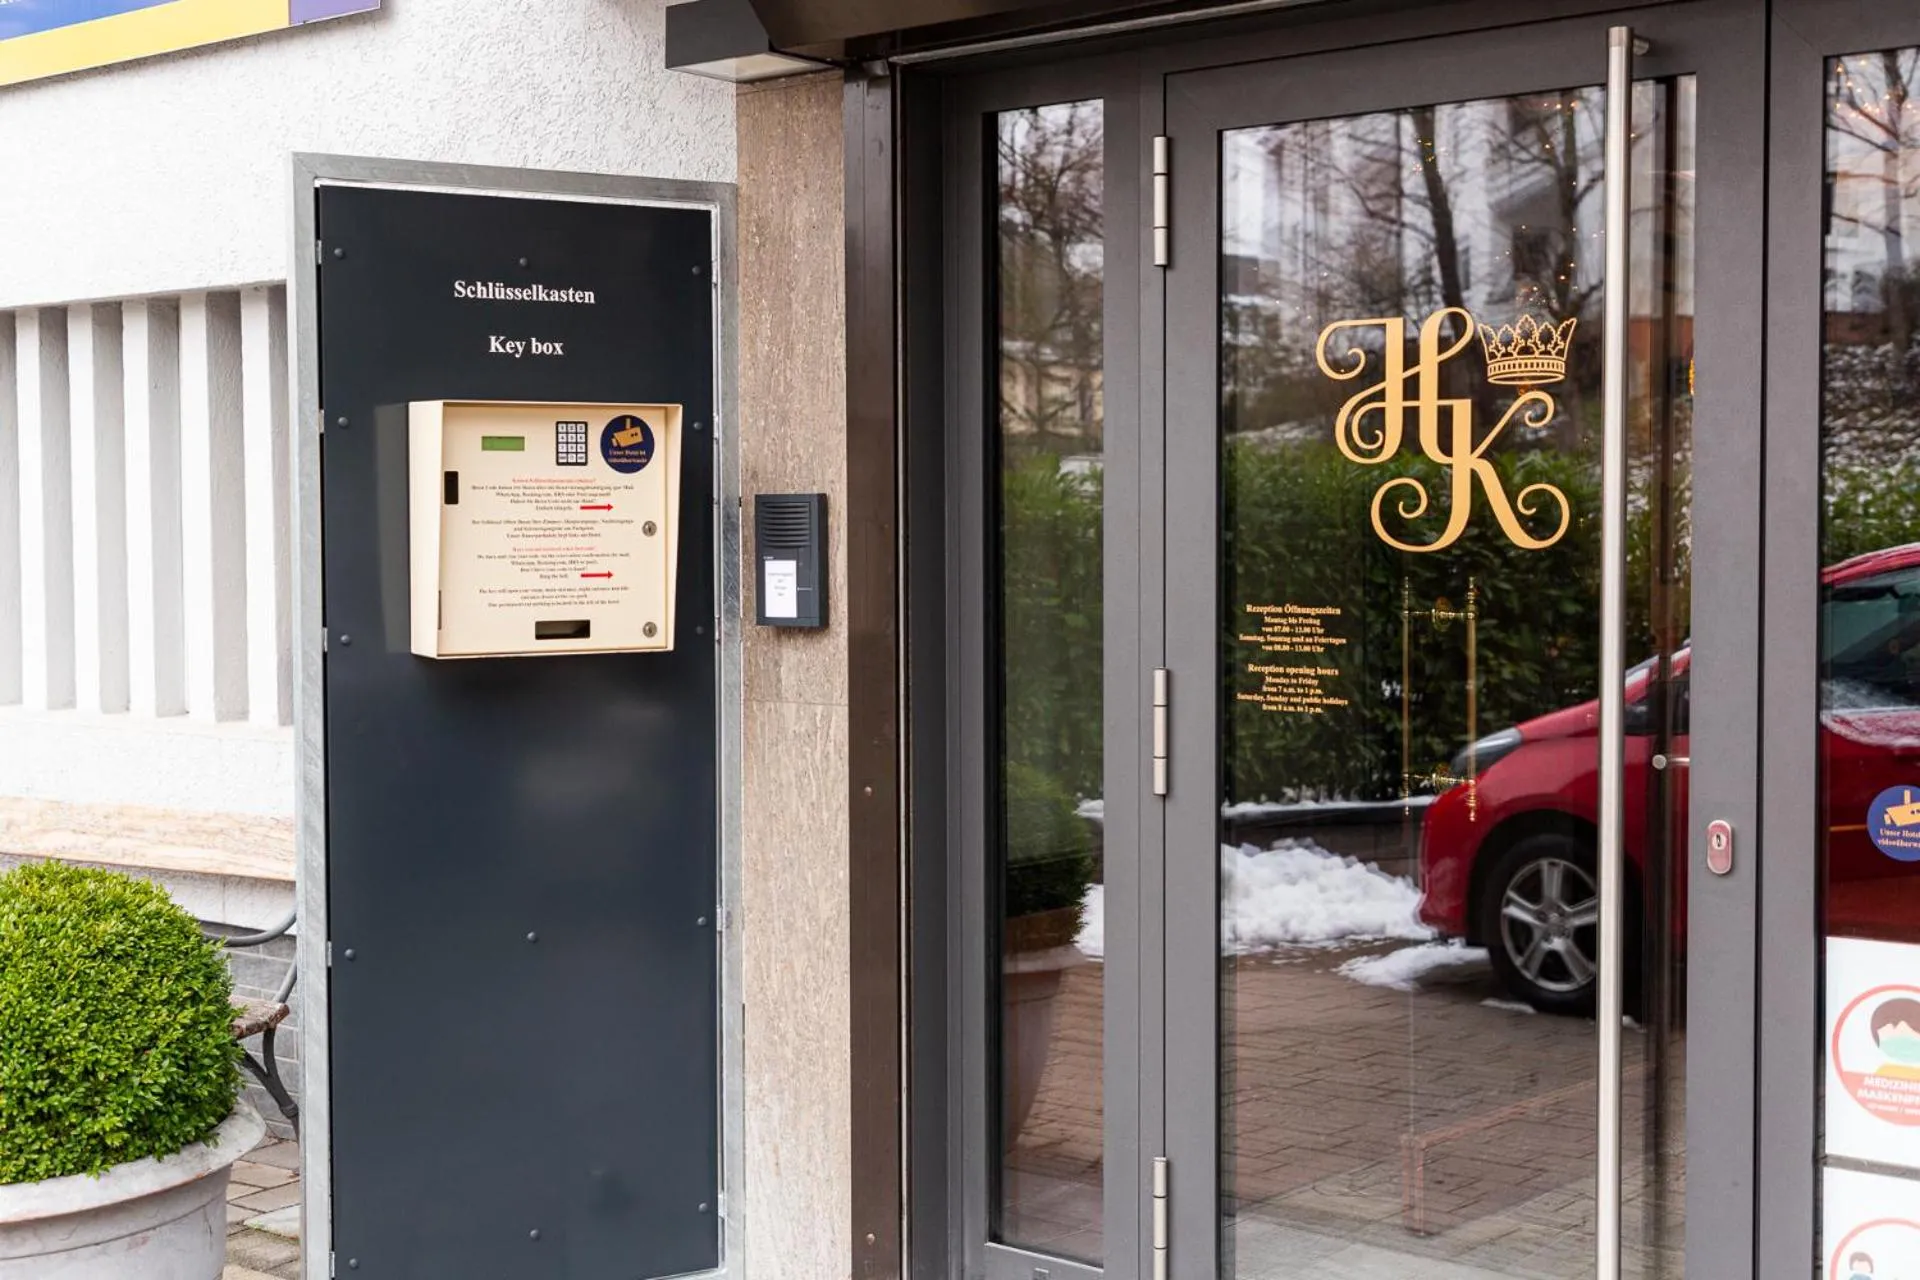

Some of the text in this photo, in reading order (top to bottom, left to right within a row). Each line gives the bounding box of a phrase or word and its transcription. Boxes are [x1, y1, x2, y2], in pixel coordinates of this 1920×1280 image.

[454, 280, 596, 304] Schlüsselkasten
[489, 335, 564, 358] Key box
[1246, 604, 1341, 616] Rezeption Öffnungszeiten
[1298, 617, 1320, 625] Freitag
[1248, 664, 1339, 676] Reception opening hours
[1265, 676, 1289, 684] Monday
[1298, 677, 1319, 686] Friday
[1266, 694, 1289, 704] Sunday
[1322, 697, 1348, 706] holidays
[1880, 828, 1900, 836] Unser
